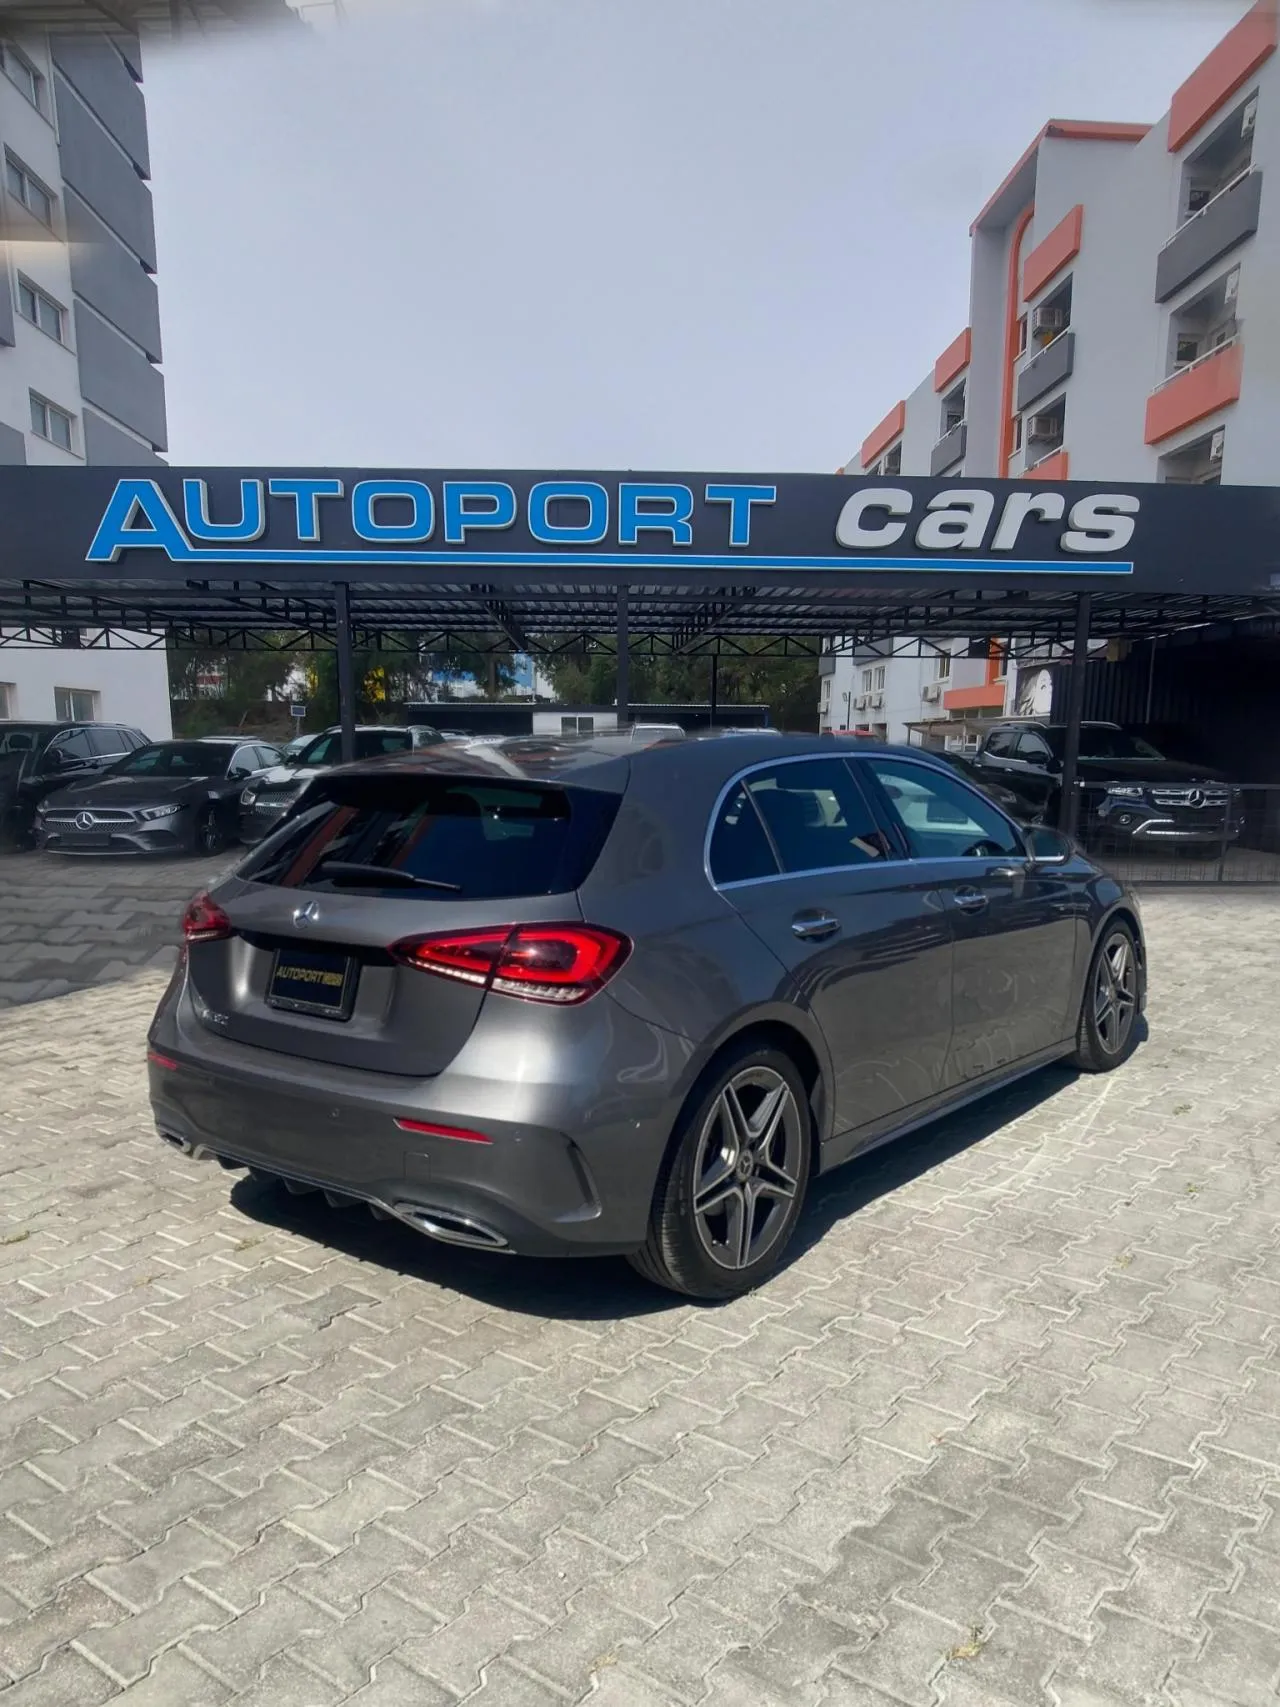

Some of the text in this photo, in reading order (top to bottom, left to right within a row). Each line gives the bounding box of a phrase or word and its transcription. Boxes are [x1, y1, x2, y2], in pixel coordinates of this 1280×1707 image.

[86, 478, 1140, 562] AUTOPORT cars
[277, 965, 323, 984] AUTOPORT
